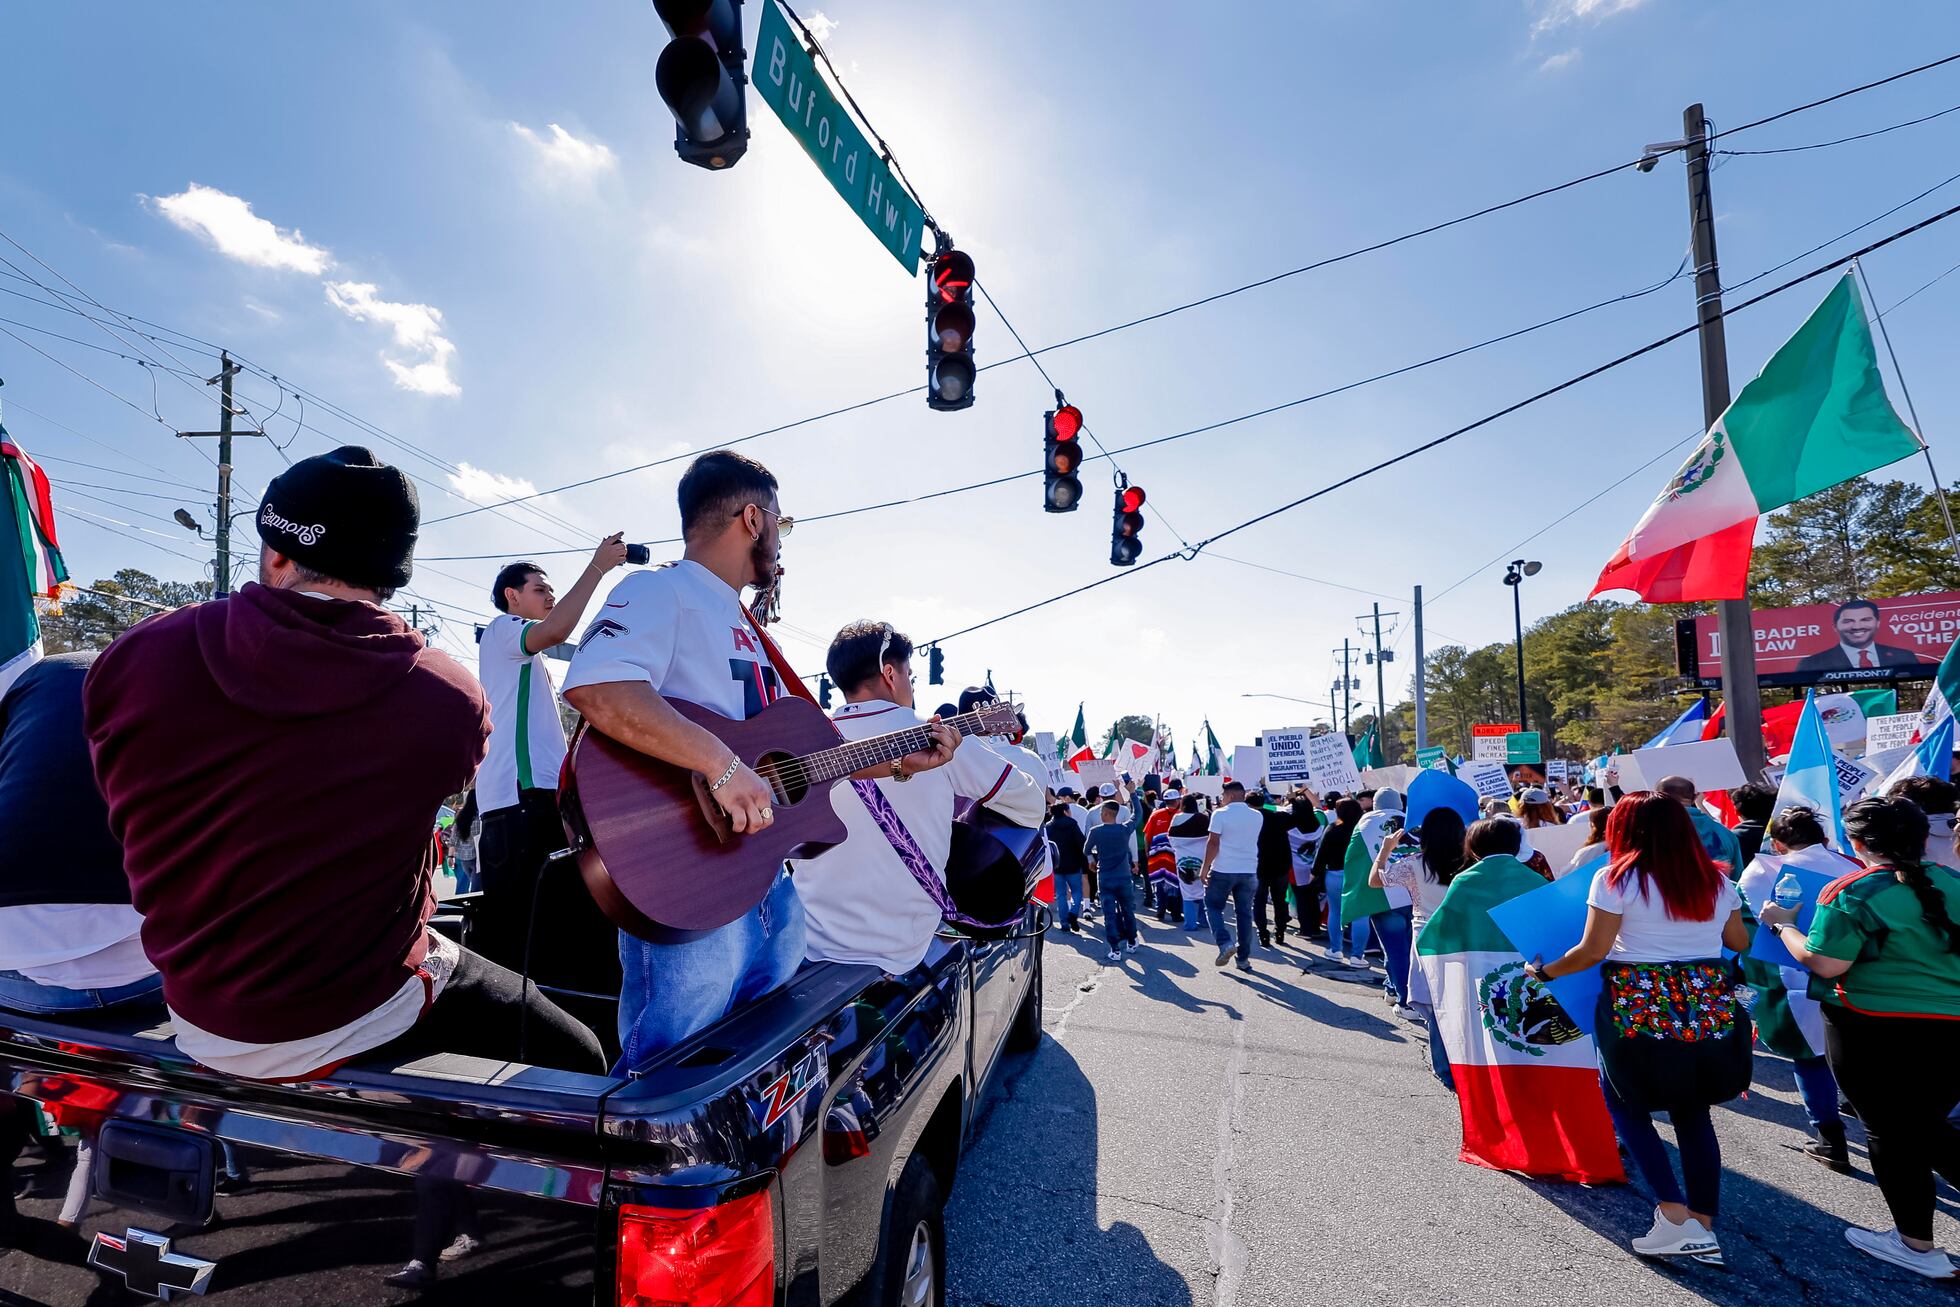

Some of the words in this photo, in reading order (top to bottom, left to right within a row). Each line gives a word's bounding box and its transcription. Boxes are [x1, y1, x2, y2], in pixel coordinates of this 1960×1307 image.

[768, 35, 858, 185] Buford
[868, 173, 913, 255] Hwy
[261, 503, 326, 546] Cannons
[1754, 625, 1821, 640] BADER
[1888, 621, 1935, 635] YOU
[1913, 632, 1954, 645] THE
[1755, 639, 1797, 653] LAW
[1888, 715, 1909, 724] POWER
[1892, 723, 1914, 731] PEOPLE
[1871, 734, 1877, 742] IS
[1878, 732, 1907, 741] STRONGER
[1271, 741, 1300, 751] UNIDO
[1836, 766, 1860, 786] TED
[1839, 759, 1867, 779] PEOPLE
[1320, 771, 1355, 788] TODO!!
[1485, 777, 1505, 785] CAUSA
[760, 1041, 829, 1133] Z71
